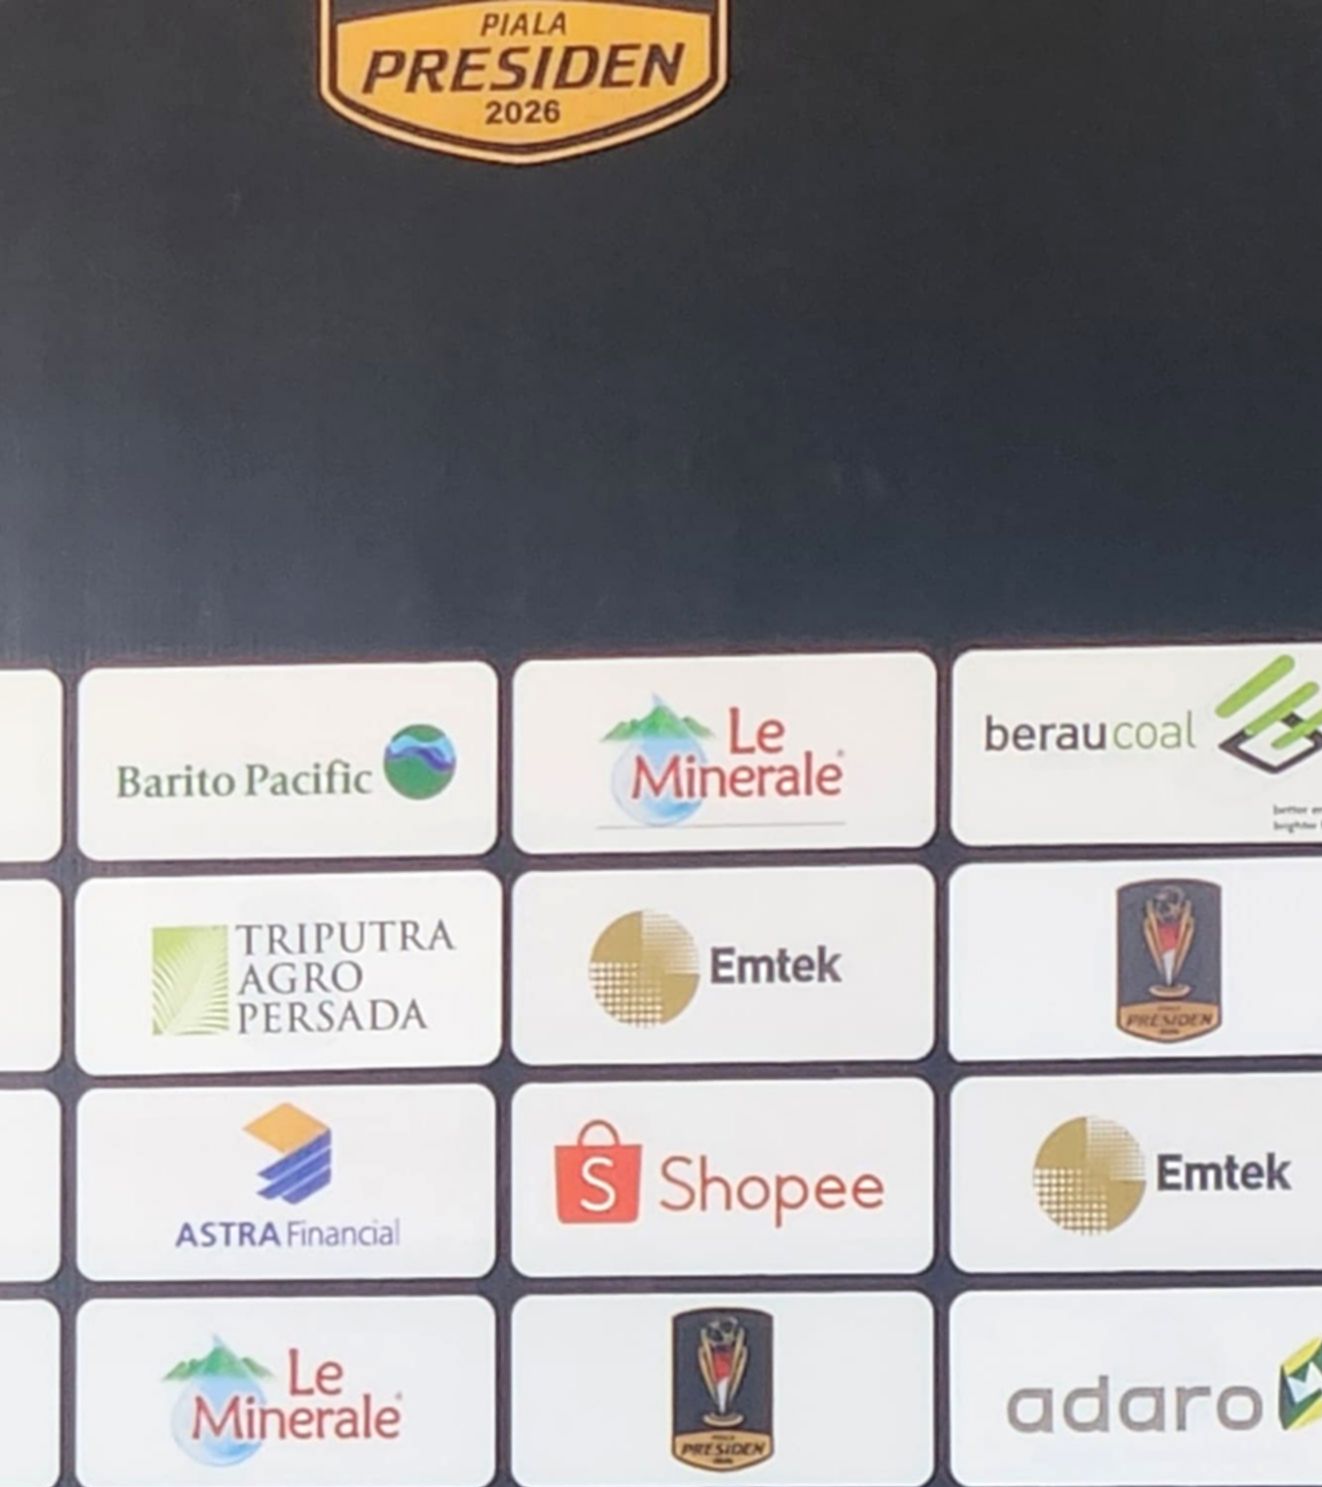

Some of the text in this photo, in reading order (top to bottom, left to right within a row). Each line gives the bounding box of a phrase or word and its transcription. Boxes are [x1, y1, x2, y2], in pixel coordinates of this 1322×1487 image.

[480, 12, 567, 36] PIALA
[361, 42, 685, 94] PRESIDEN
[484, 99, 561, 125] 2026
[729, 707, 784, 755] Le
[118, 759, 372, 797] Barito Pacific
[632, 749, 842, 797] Minerale
[236, 920, 454, 955] TRIPUTRA
[239, 961, 362, 995] AGRO
[711, 945, 842, 984] Emtek
[239, 999, 427, 1034] PERSADA
[1157, 1152, 1291, 1191] Emtek
[660, 1155, 884, 1228] Shopee
[176, 1221, 401, 1247] ASTRA Financial
[289, 1351, 341, 1396] Le
[192, 1394, 397, 1438] Minerale
[1007, 1375, 1262, 1433] adaro
